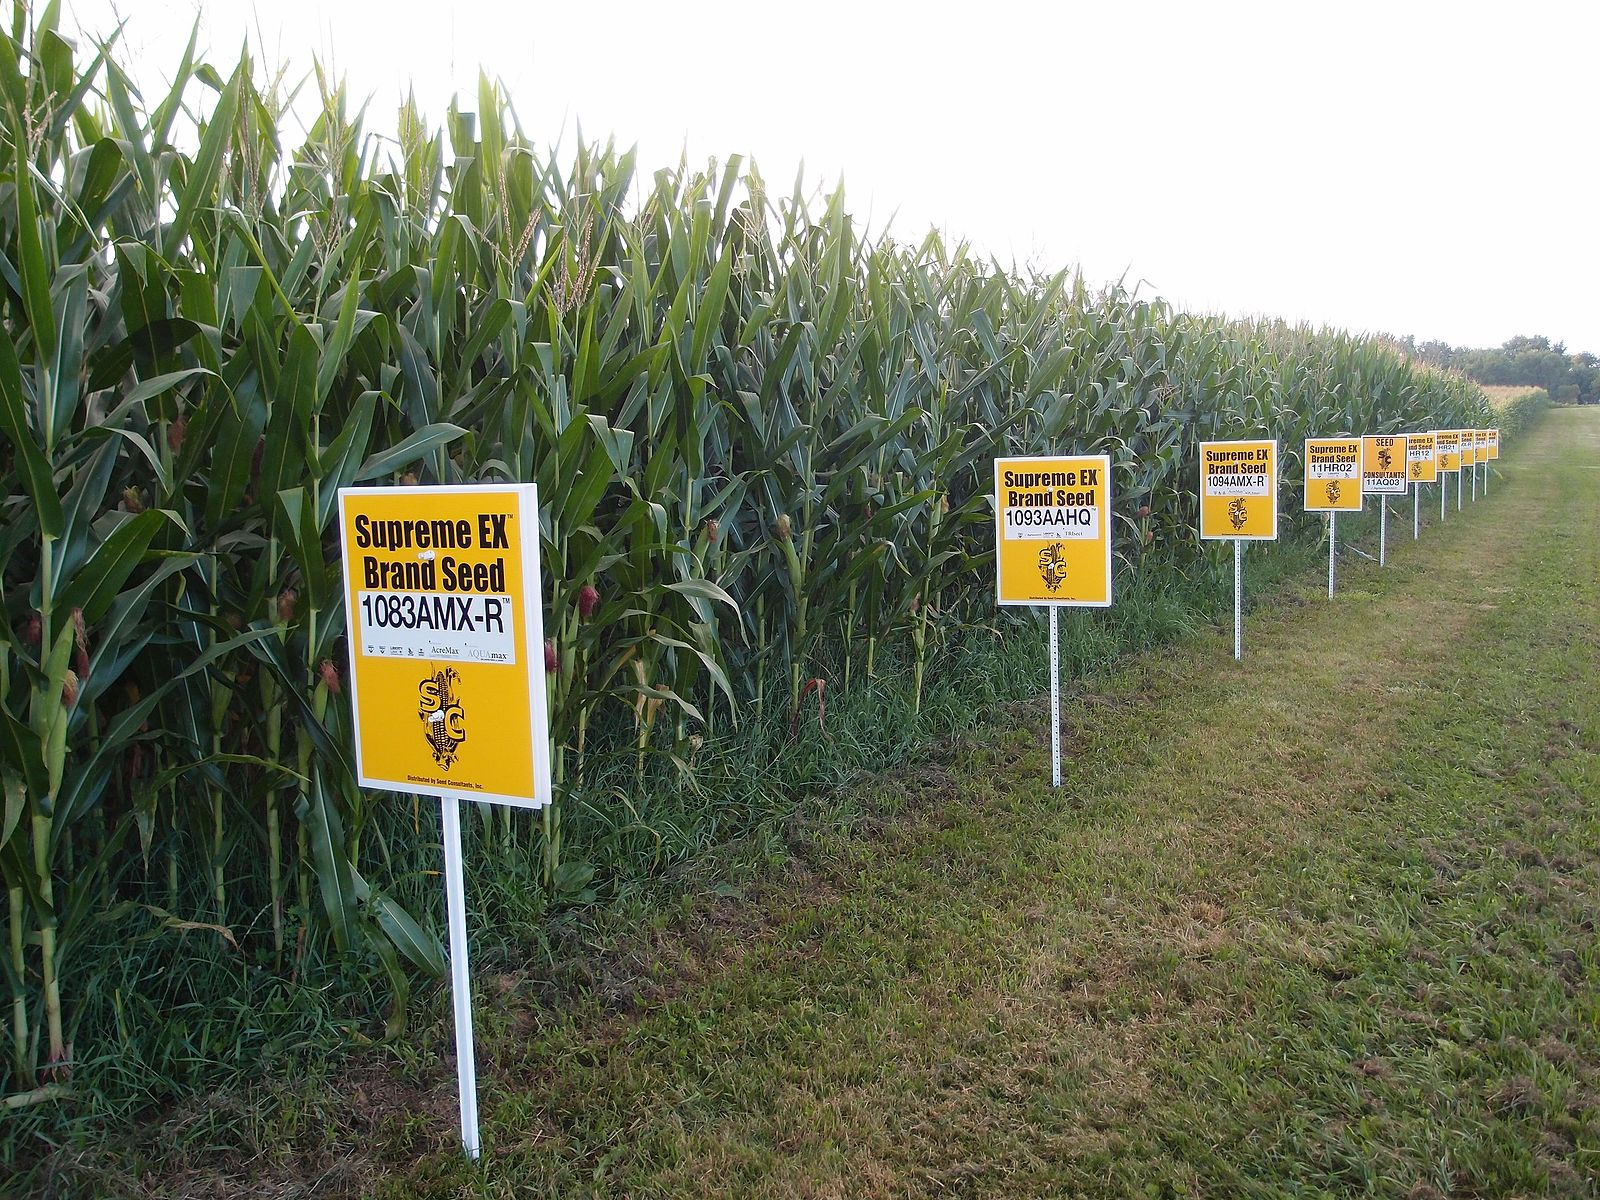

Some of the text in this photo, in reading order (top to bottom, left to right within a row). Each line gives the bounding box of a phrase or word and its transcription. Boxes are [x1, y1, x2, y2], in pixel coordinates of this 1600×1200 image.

[1375, 438, 1394, 447] SEED
[1309, 445, 1347, 454] Supreme
[1206, 450, 1254, 462] Supreme
[1311, 454, 1356, 463] Brand Seed
[1208, 463, 1266, 474] Brand Seed
[1311, 463, 1353, 472] 11HR02
[1004, 471, 1076, 488] Supreme
[1363, 471, 1405, 479] CONSULTANTS
[1366, 478, 1400, 486] 11AQ03
[1008, 490, 1095, 507] Brand Seed
[355, 514, 472, 552] Supreme
[364, 556, 506, 593] Brand Seed
[431, 645, 459, 655] AcreMax
[407, 775, 430, 783] Distributed
